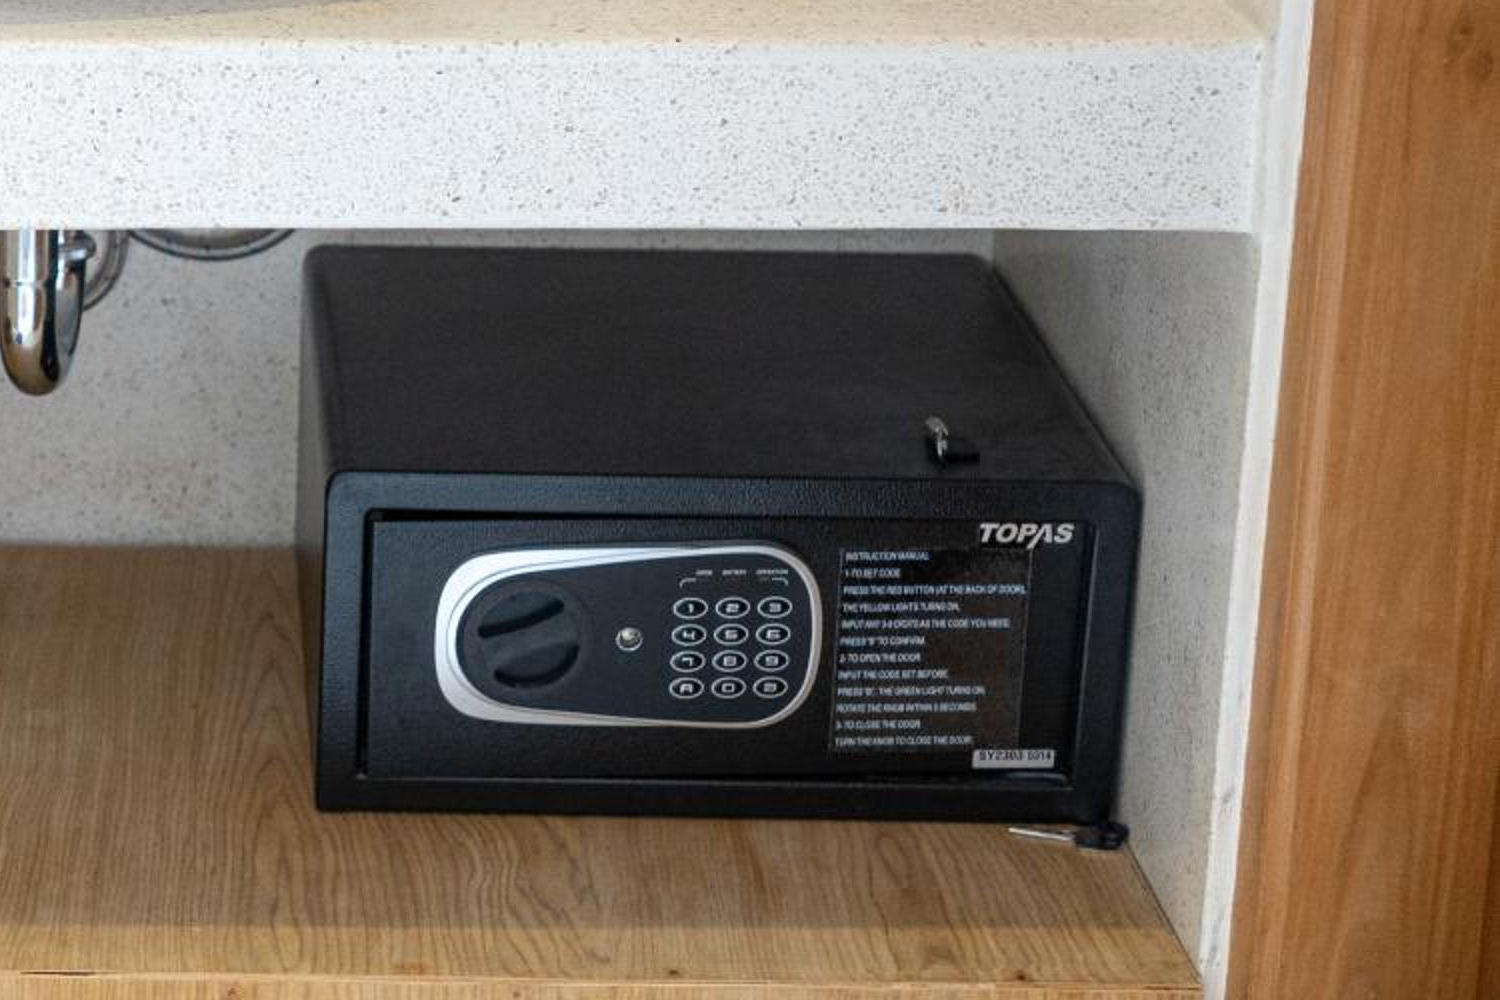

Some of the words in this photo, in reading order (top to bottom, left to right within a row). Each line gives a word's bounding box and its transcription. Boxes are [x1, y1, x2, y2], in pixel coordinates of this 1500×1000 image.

[979, 522, 1076, 549] TOPAS
[845, 551, 897, 562] INSTRUCTION
[897, 551, 930, 562] MANUAL
[904, 584, 935, 596] BUTTON
[725, 603, 740, 613] 2
[769, 602, 782, 613] 3
[947, 618, 968, 630] CODE
[682, 630, 696, 640] 4
[725, 629, 739, 640] 5
[766, 629, 781, 640] 6
[682, 657, 695, 667] 7
[723, 656, 738, 667] 8
[765, 656, 780, 667] 9
[860, 652, 880, 664] OPEN
[680, 683, 695, 694] A
